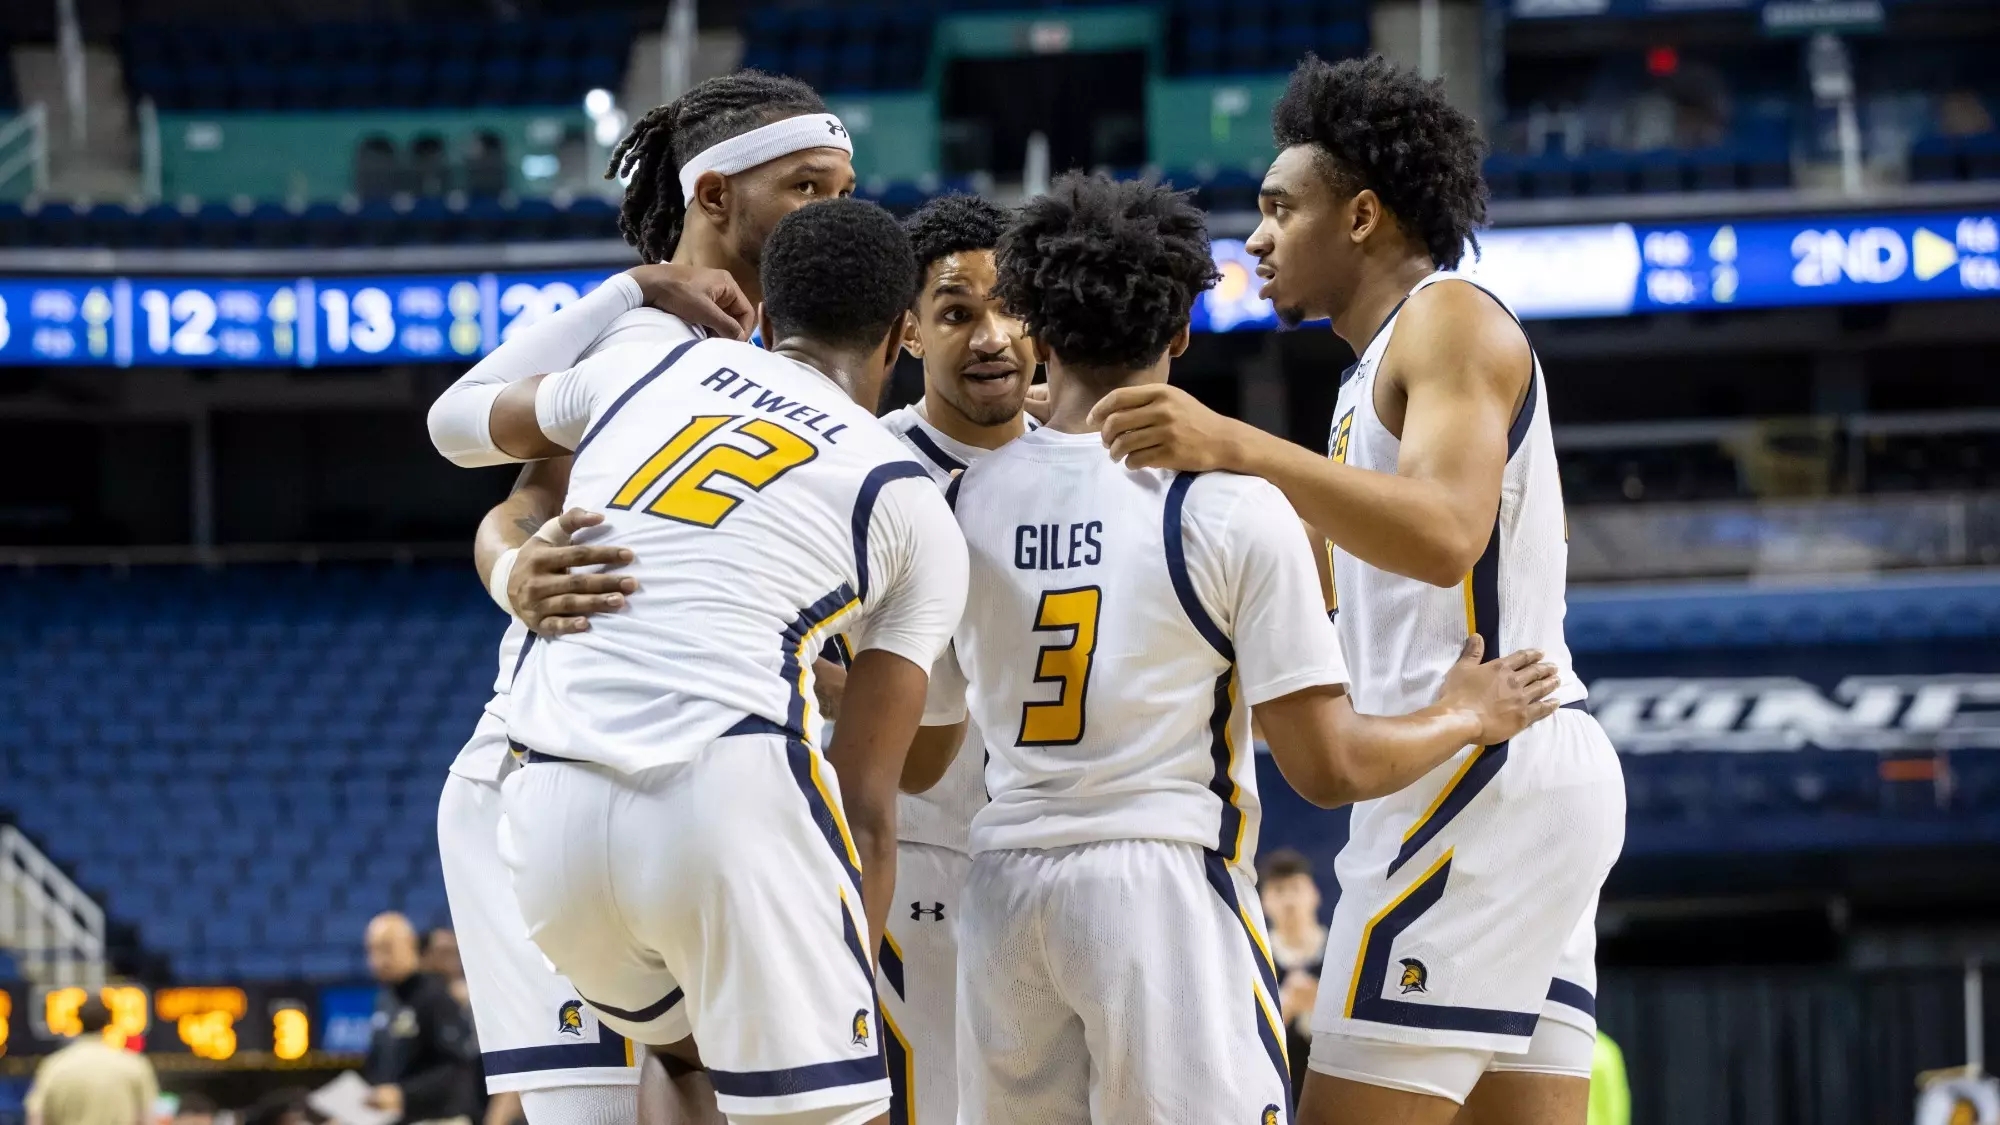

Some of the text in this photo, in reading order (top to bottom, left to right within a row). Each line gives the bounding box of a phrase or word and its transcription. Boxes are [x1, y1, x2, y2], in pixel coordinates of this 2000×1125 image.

[1791, 227, 1908, 287] 2ND
[140, 289, 217, 355] 12
[319, 287, 396, 353] 13
[700, 367, 848, 445] ATWELL
[605, 414, 819, 529] 12
[1015, 520, 1103, 570] GILES
[1014, 584, 1102, 747] 3
